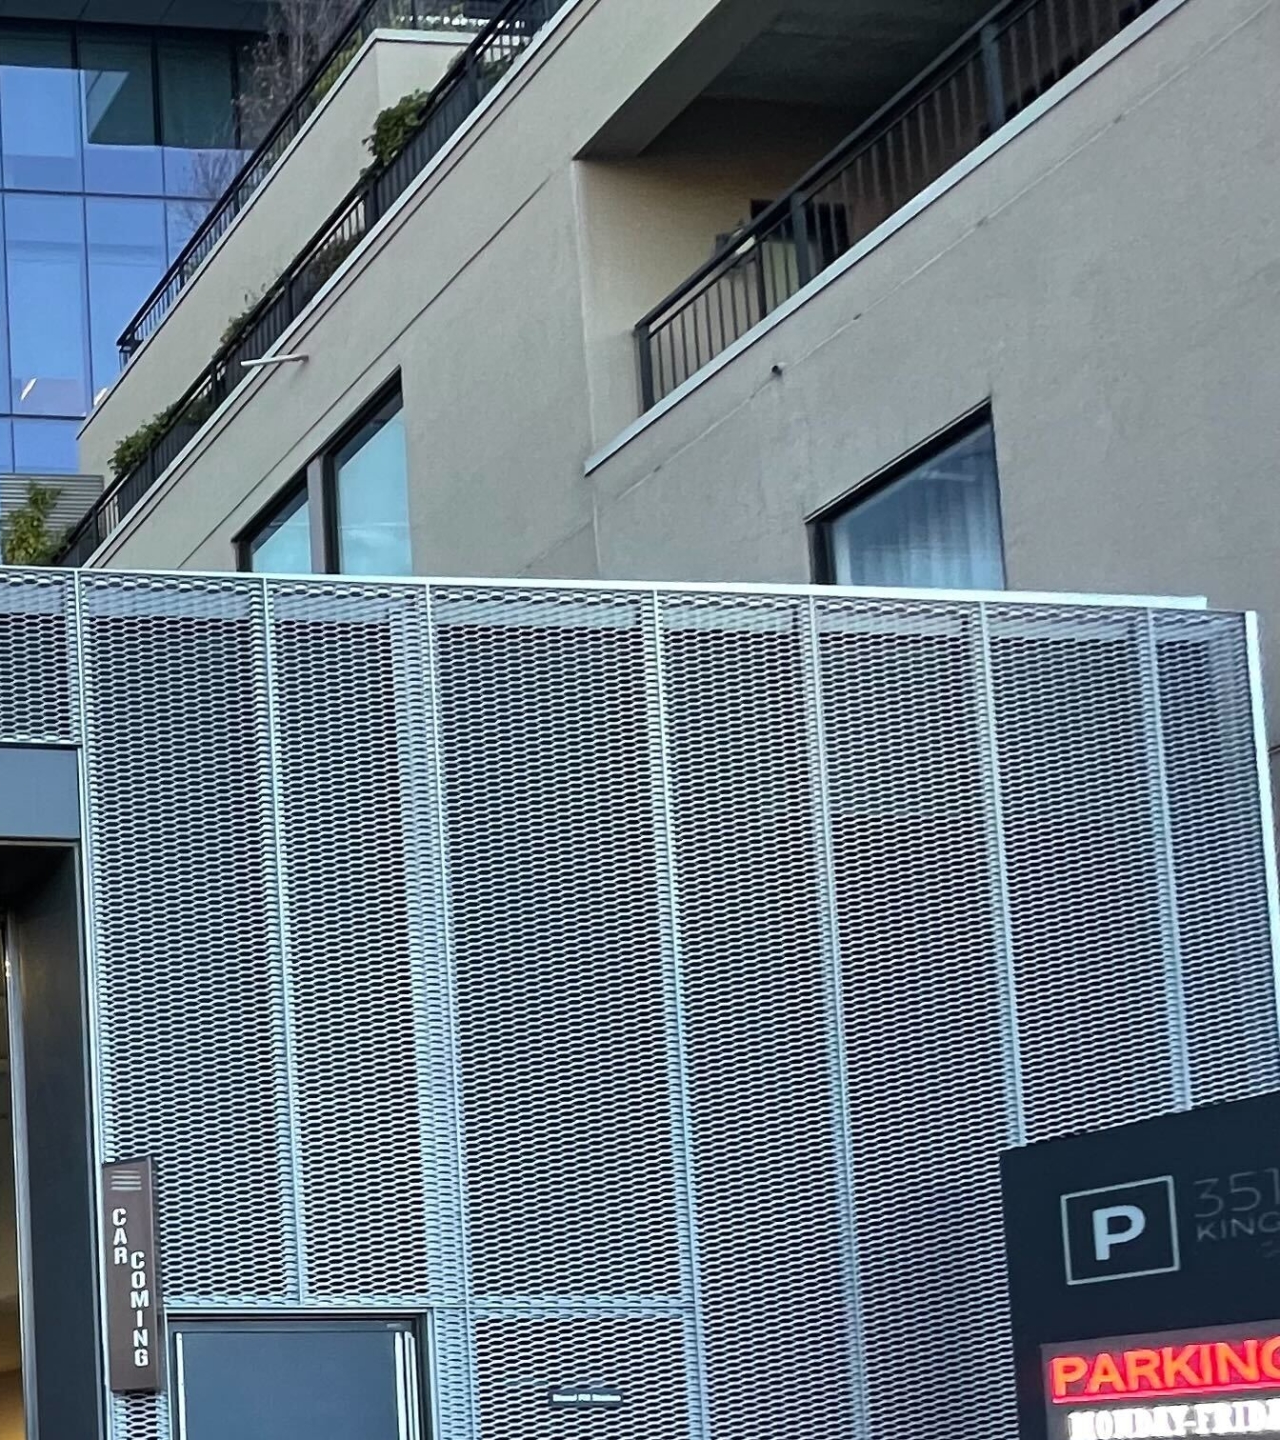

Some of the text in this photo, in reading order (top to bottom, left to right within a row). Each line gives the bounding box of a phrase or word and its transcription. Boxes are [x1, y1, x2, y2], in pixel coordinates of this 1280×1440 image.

[1193, 1167, 1280, 1218] 351
[1093, 1204, 1146, 1261] P
[1196, 1211, 1280, 1242] KING
[112, 1207, 150, 1368] CAR COMING
